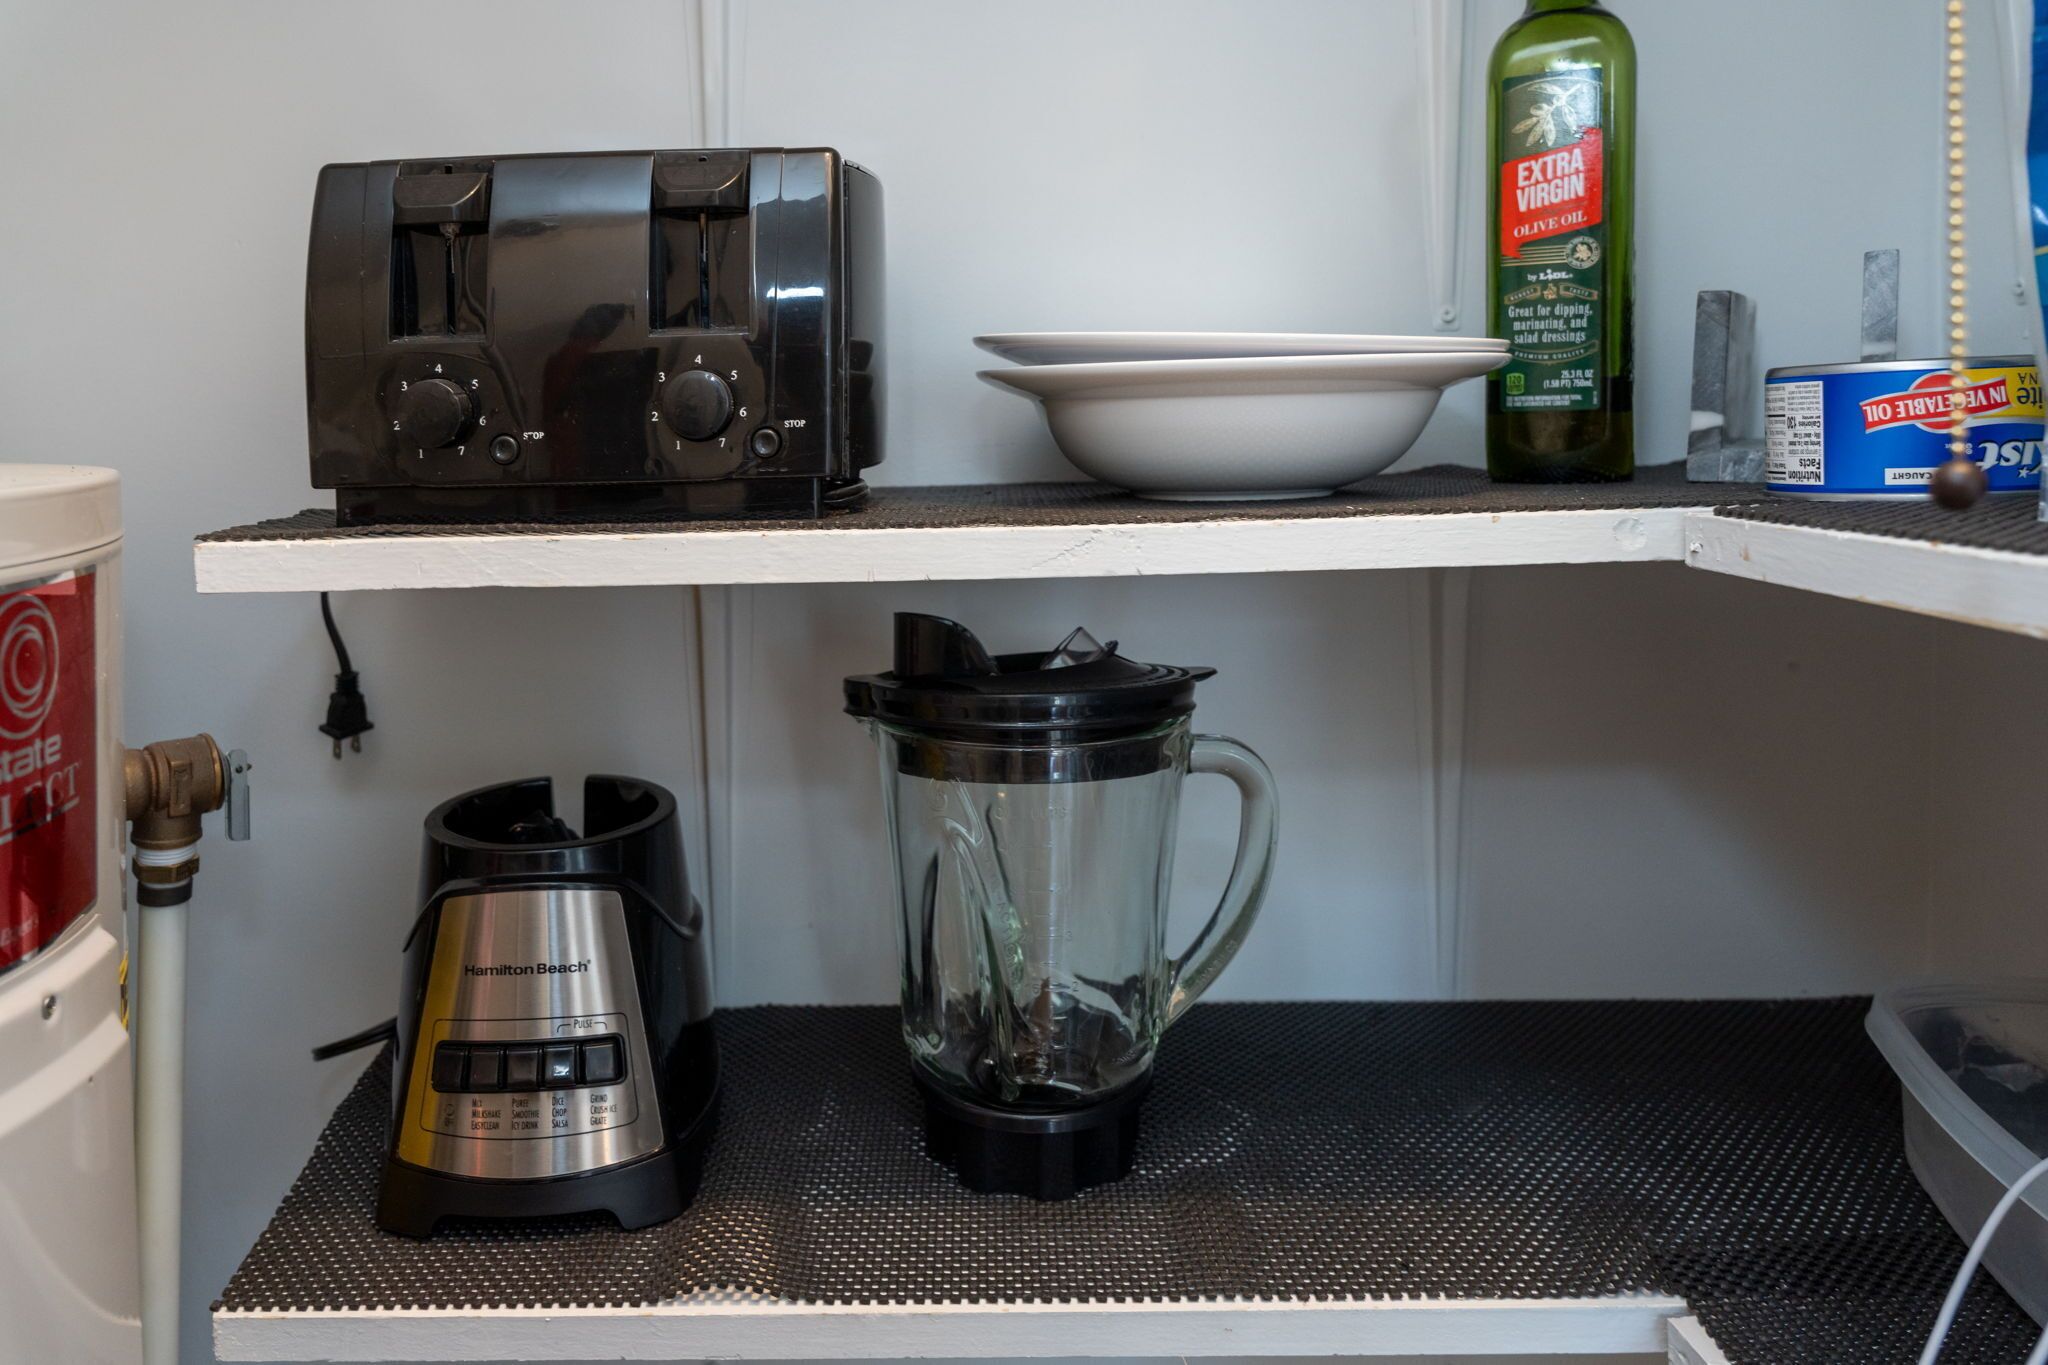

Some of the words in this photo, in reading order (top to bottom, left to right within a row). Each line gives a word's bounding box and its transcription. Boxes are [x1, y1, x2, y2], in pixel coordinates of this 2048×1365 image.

[1517, 148, 1584, 187] EXTRA
[1516, 172, 1585, 212] VIRGIN
[1513, 217, 1558, 238] OLIVE
[1560, 211, 1588, 228] OIL
[1527, 273, 1538, 282] by
[1508, 304, 1534, 317] Great
[1537, 303, 1551, 316] for
[1554, 302, 1593, 318] dipping,
[1570, 316, 1588, 328] and
[1514, 332, 1538, 344] salad
[1541, 330, 1586, 344] dressings
[694, 354, 702, 365] 4
[1514, 350, 1549, 360] PREMIUM
[1552, 349, 1585, 359] QUALITY
[434, 363, 443, 374] 4
[658, 371, 666, 383] 3
[730, 370, 738, 381] 5
[401, 381, 408, 392] 3
[471, 379, 479, 390] 5
[1989, 385, 2007, 404] IN
[651, 411, 659, 422] 2
[739, 406, 747, 418] 6
[1862, 404, 1892, 422] OIL
[479, 415, 487, 426] 6
[784, 419, 806, 428] STOP
[1798, 420, 1821, 429] Calories
[523, 431, 545, 440] STOP
[718, 437, 726, 448] 7
[457, 445, 465, 456] 7
[1799, 458, 1821, 470] Facts
[1787, 470, 1822, 482] Nutrition
[1892, 472, 1933, 481] CAUGHT
[464, 963, 534, 976] Hamilton
[537, 961, 588, 975] Beach
[573, 1019, 593, 1029] PULSE
[552, 1096, 564, 1106] DICE
[552, 1107, 568, 1117] CHOP
[590, 1105, 608, 1114] CRUSH
[552, 1119, 569, 1129] SALSA
[590, 1116, 608, 1125] GRATE
